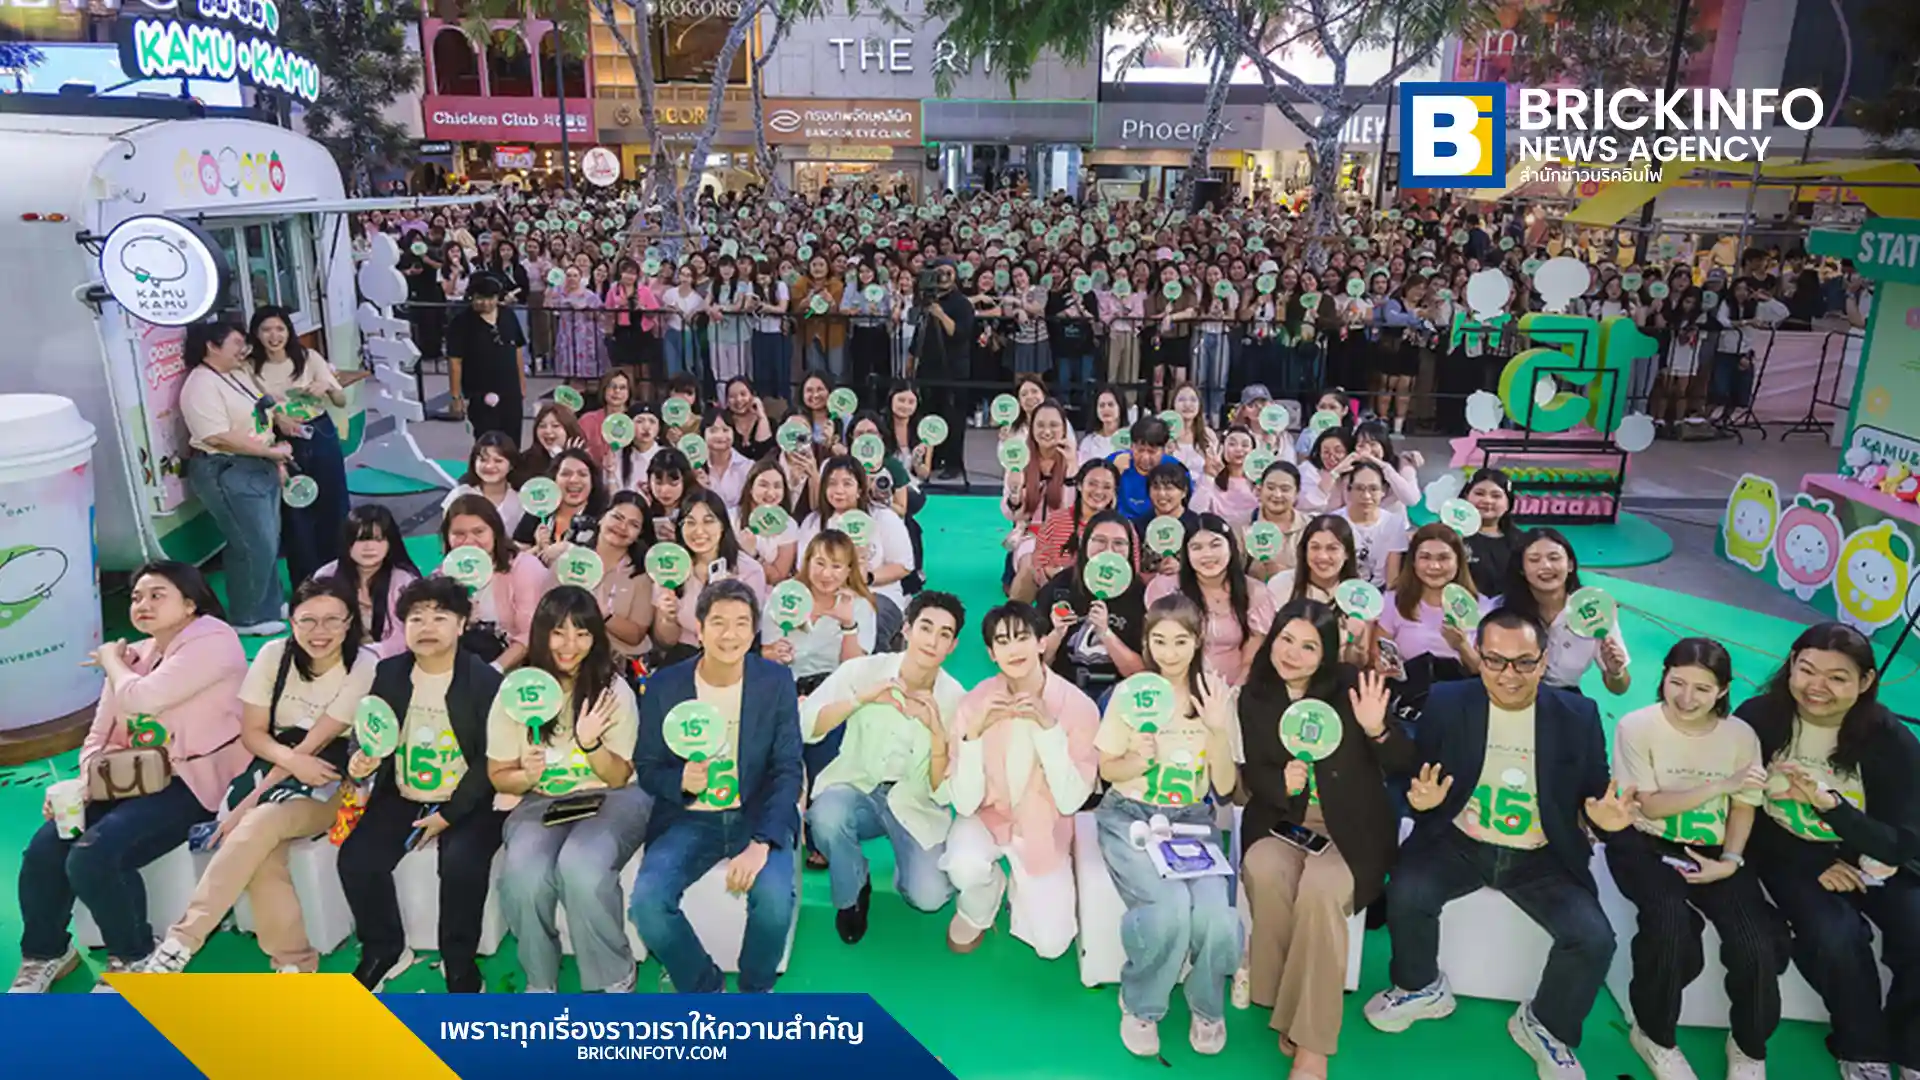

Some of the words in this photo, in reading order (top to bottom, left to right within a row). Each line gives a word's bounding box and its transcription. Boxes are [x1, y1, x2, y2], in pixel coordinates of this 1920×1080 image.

[828, 37, 914, 72] THE
[138, 26, 236, 73] KAMU
[251, 40, 318, 98] KAMU
[432, 111, 498, 126] Chicken
[501, 111, 539, 126] Club
[805, 129, 853, 139] BANGKOK
[855, 129, 876, 139] EYE
[878, 129, 912, 139] CLINIC
[136, 288, 186, 299] KAMU
[138, 299, 188, 310] KAMU
